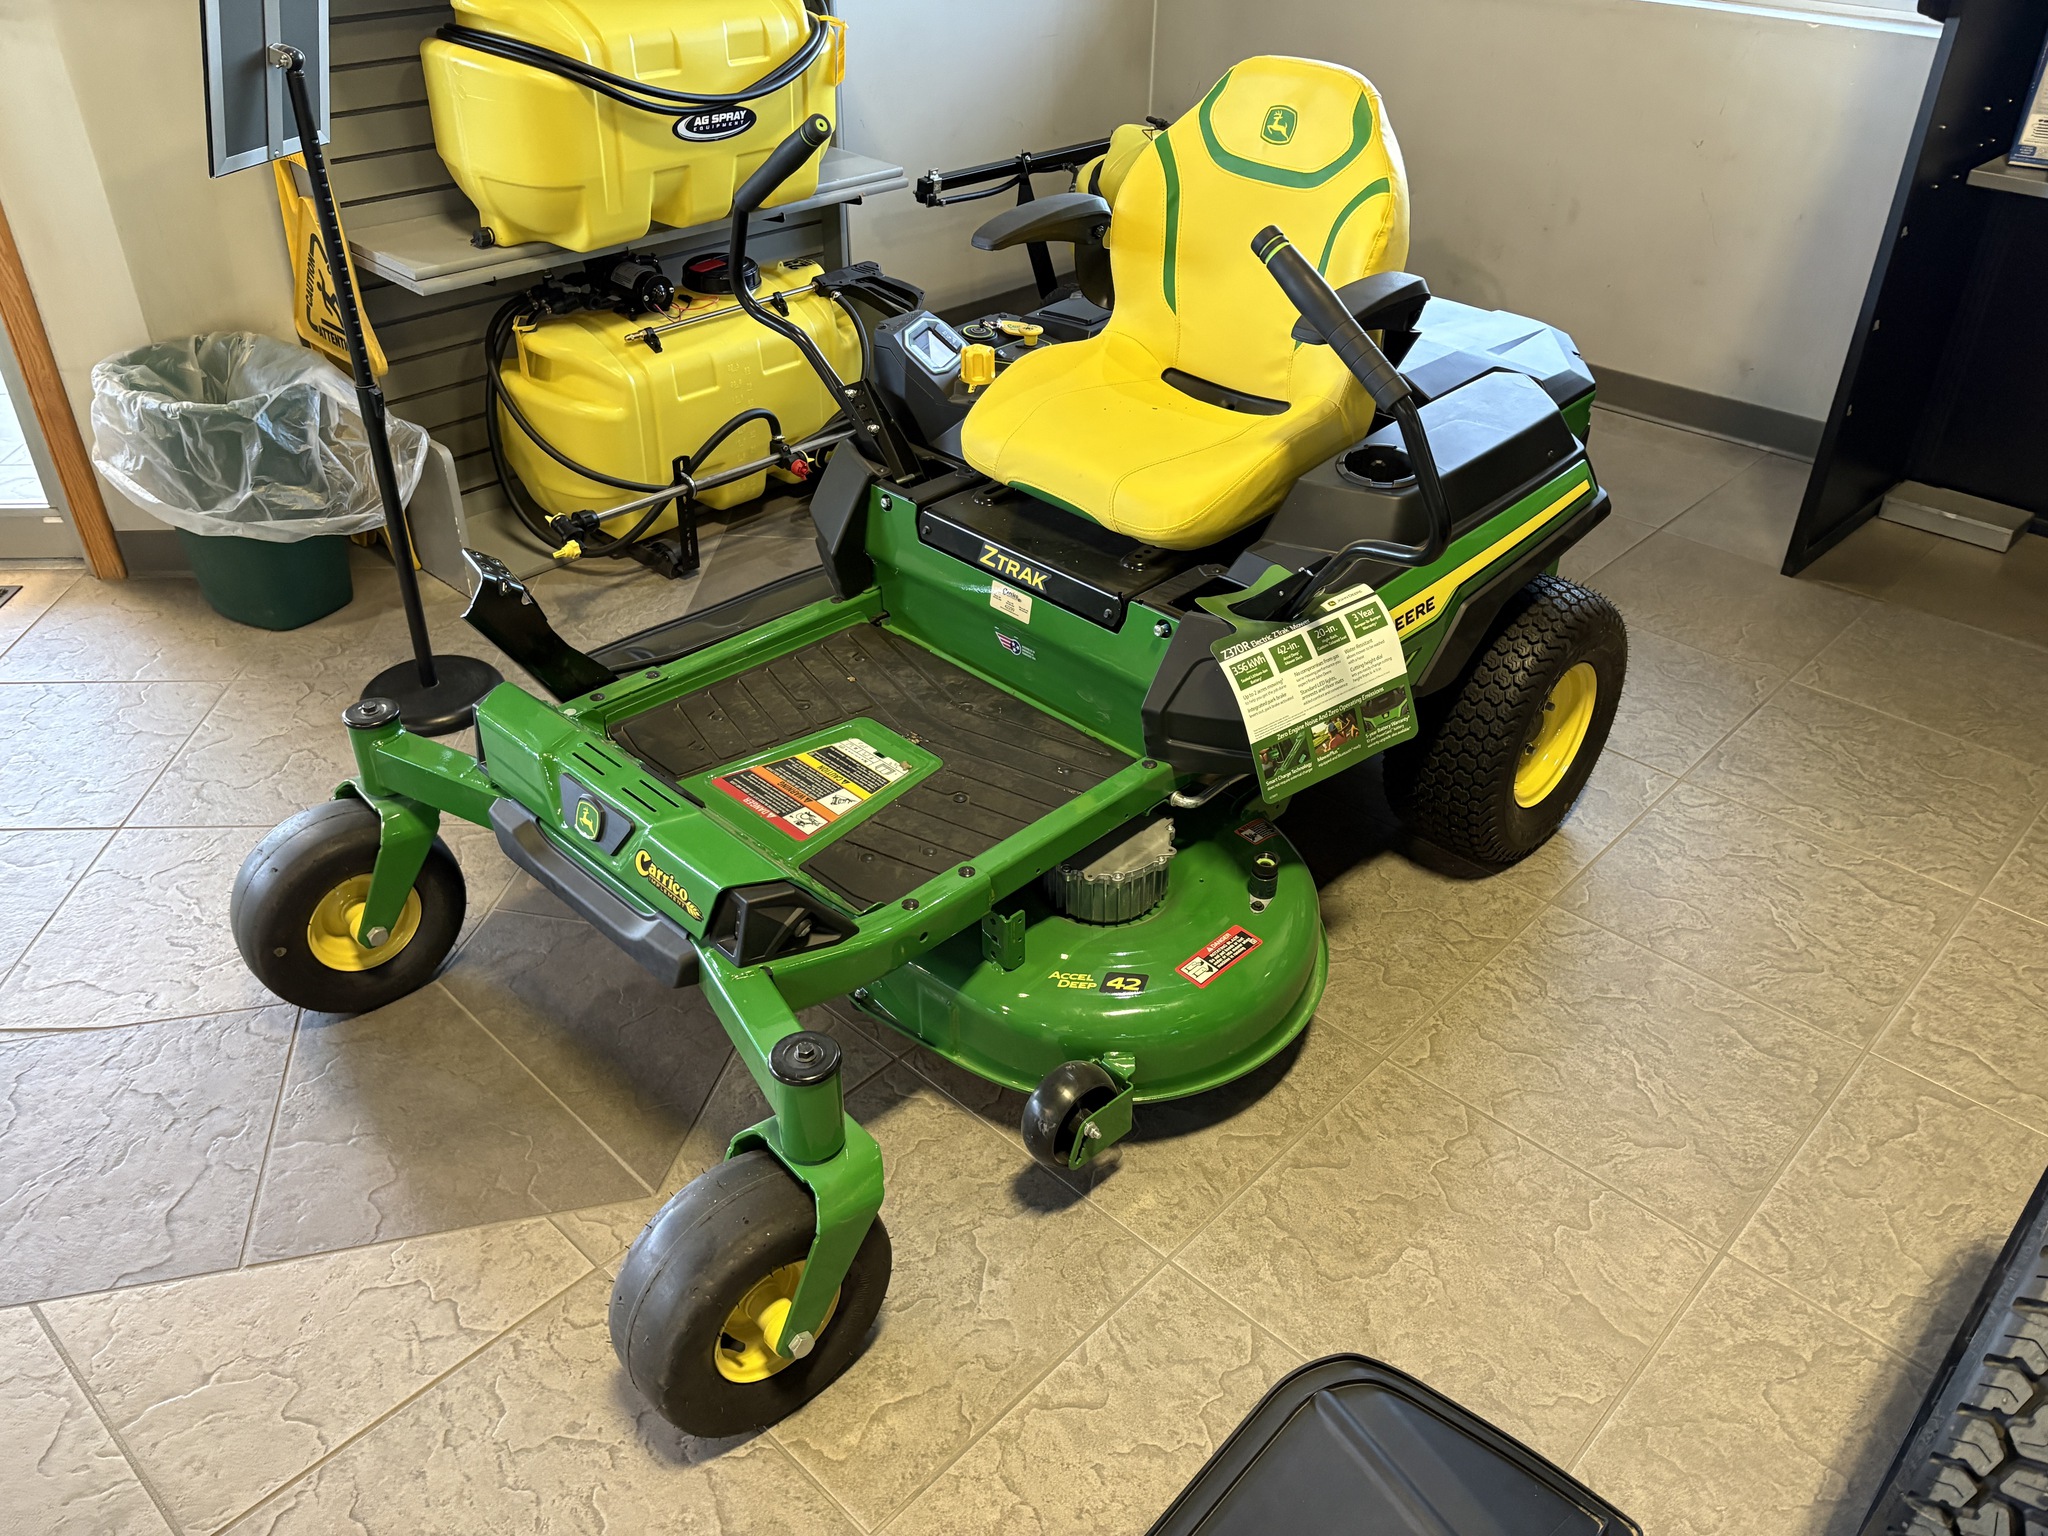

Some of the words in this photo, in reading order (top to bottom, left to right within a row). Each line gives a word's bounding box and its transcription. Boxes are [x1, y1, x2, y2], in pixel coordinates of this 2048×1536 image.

[694, 116, 709, 126] AG
[712, 110, 747, 124] SPRAY
[694, 121, 744, 132] EQUIPMENT
[306, 253, 316, 308] CAUTION
[981, 545, 1046, 589] ZTRAK
[1352, 613, 1359, 622] 3
[1357, 608, 1374, 618] Year
[1395, 596, 1435, 632] EERE
[1314, 626, 1338, 638] 20-in.
[1220, 642, 1250, 659] Z370R
[1250, 635, 1272, 647] Electric
[1277, 643, 1299, 654] 42-in.
[1247, 654, 1266, 668] kWh
[1288, 725, 1304, 735] Engine
[1304, 718, 1318, 727] Noise
[1319, 712, 1328, 721] And
[1339, 698, 1362, 711] Operating
[1362, 687, 1384, 700] Emissions
[817, 765, 843, 781] CAUTION
[1266, 778, 1278, 786] Smart
[1278, 772, 1291, 780] Charge
[1291, 762, 1312, 773] Technology
[777, 781, 806, 800] WARNING
[743, 797, 770, 814] DANGER
[636, 851, 687, 900] Carrico
[649, 878, 684, 907] IMPLEMENT
[1211, 933, 1231, 949] DANGER
[1048, 971, 1094, 981] ACCEL
[1057, 980, 1097, 989] DEEP
[1106, 977, 1141, 991] 42
